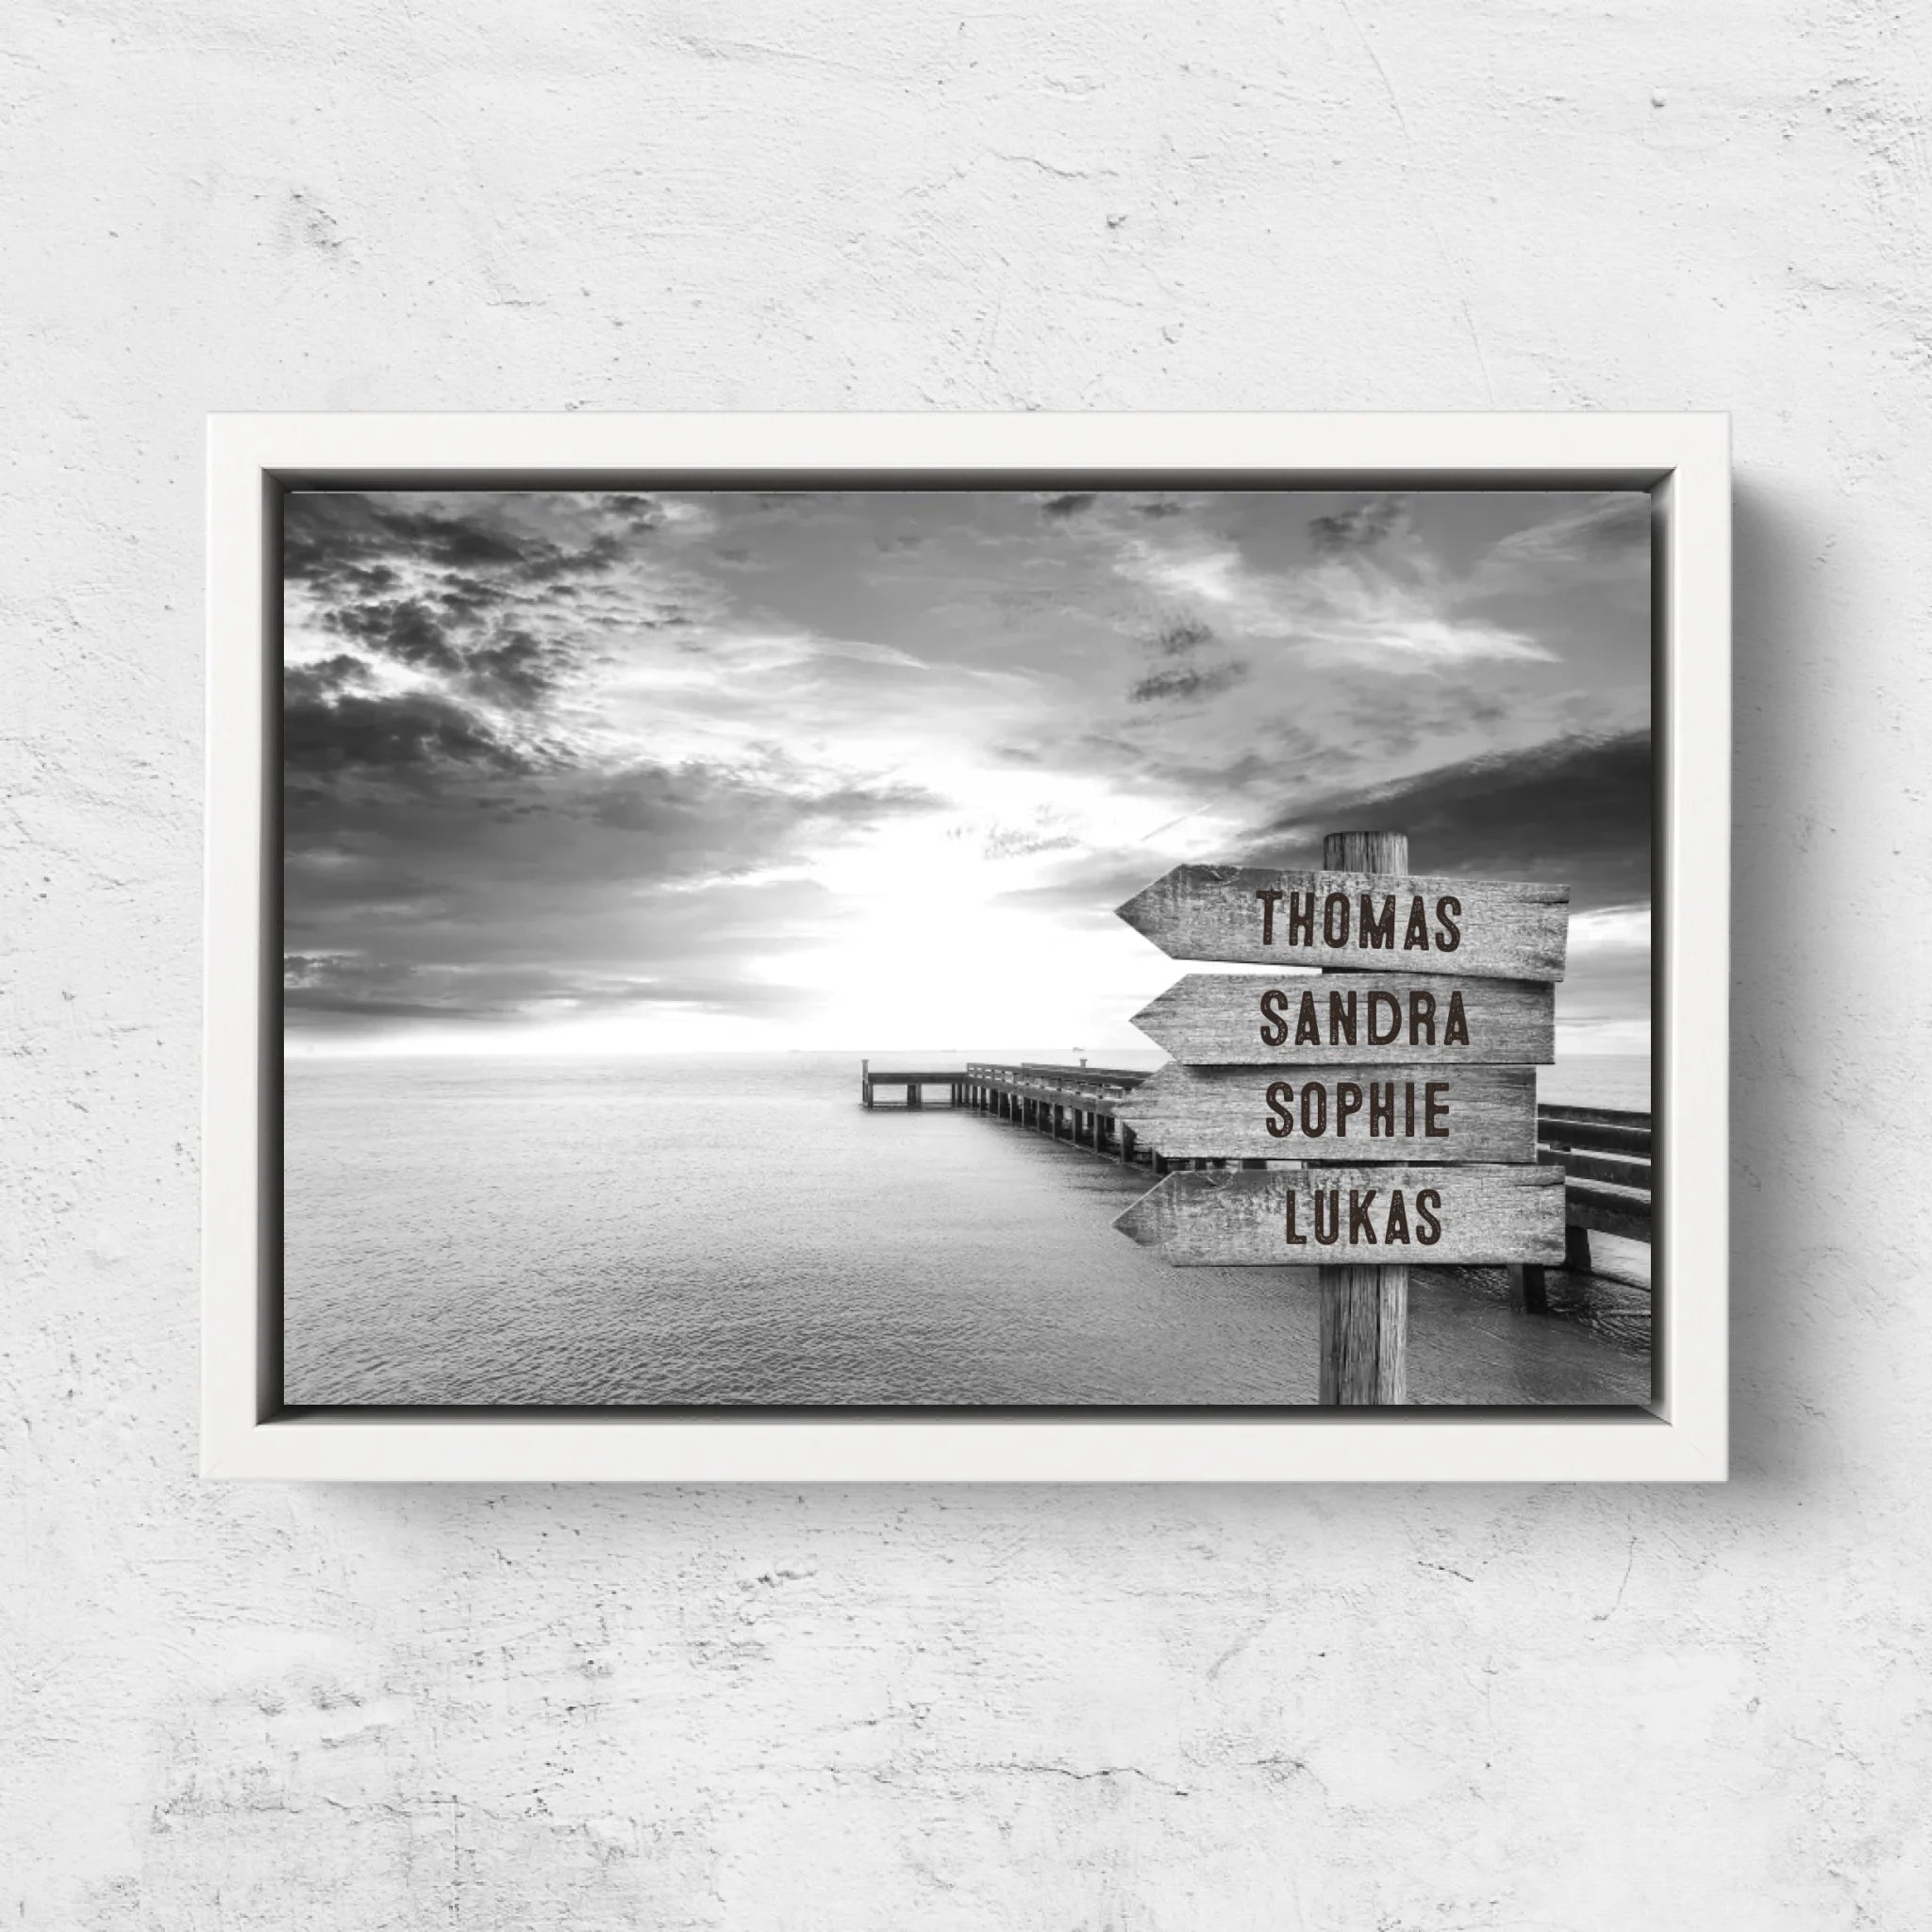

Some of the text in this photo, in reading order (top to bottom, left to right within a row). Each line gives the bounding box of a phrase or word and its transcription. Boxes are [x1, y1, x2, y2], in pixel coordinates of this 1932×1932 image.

[1256, 890, 1462, 952] THOMAS
[1259, 990, 1471, 1047] SANDRA
[1265, 1081, 1450, 1138] SOPHIE
[1285, 1189, 1442, 1246] LUKAS
